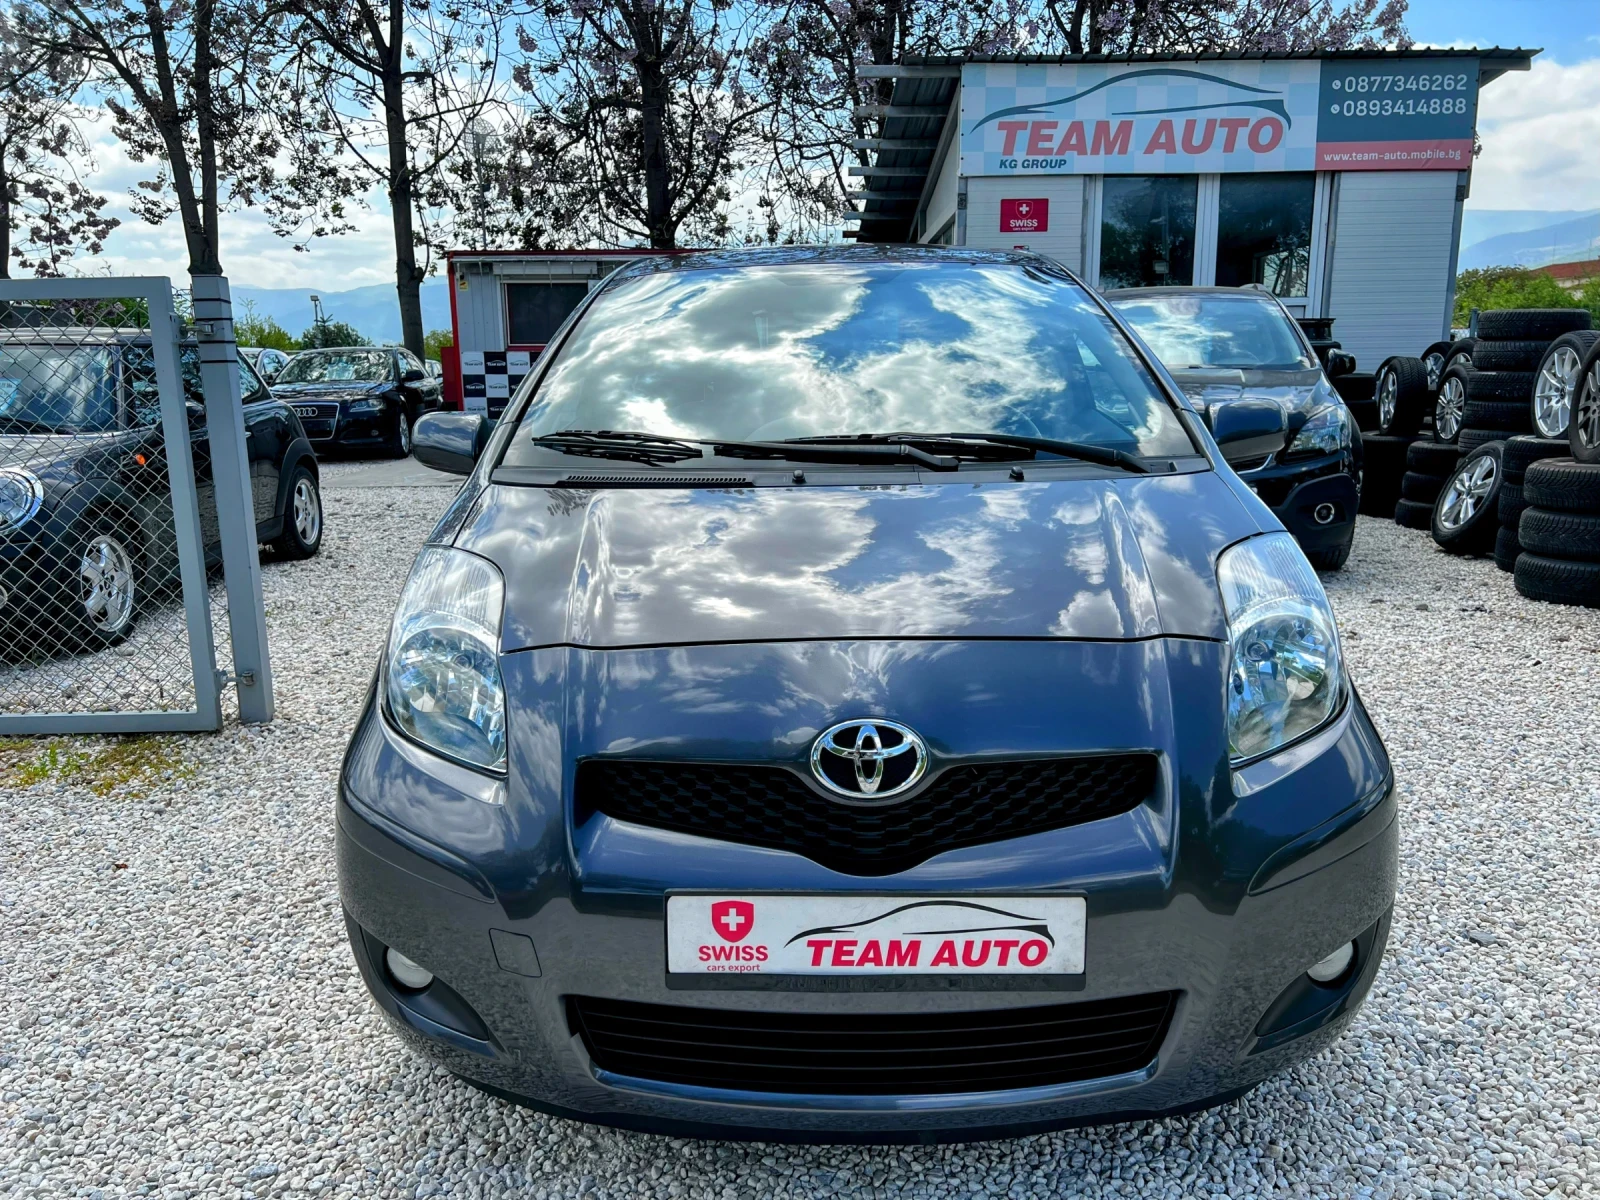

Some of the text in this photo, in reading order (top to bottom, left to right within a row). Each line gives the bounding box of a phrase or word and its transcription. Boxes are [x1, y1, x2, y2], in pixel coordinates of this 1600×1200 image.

[1344, 74, 1468, 93] 0877346262
[1343, 98, 1467, 117] 0893414888
[997, 116, 1284, 156] TEAM AUTO
[1323, 149, 1461, 161] www.team-auto.mobile.bg
[999, 159, 1067, 169] KG GROUP
[1009, 219, 1038, 227] SWISS
[698, 945, 769, 962] SWISS
[806, 938, 1049, 967] TEAM AUTO
[728, 964, 760, 974] export
